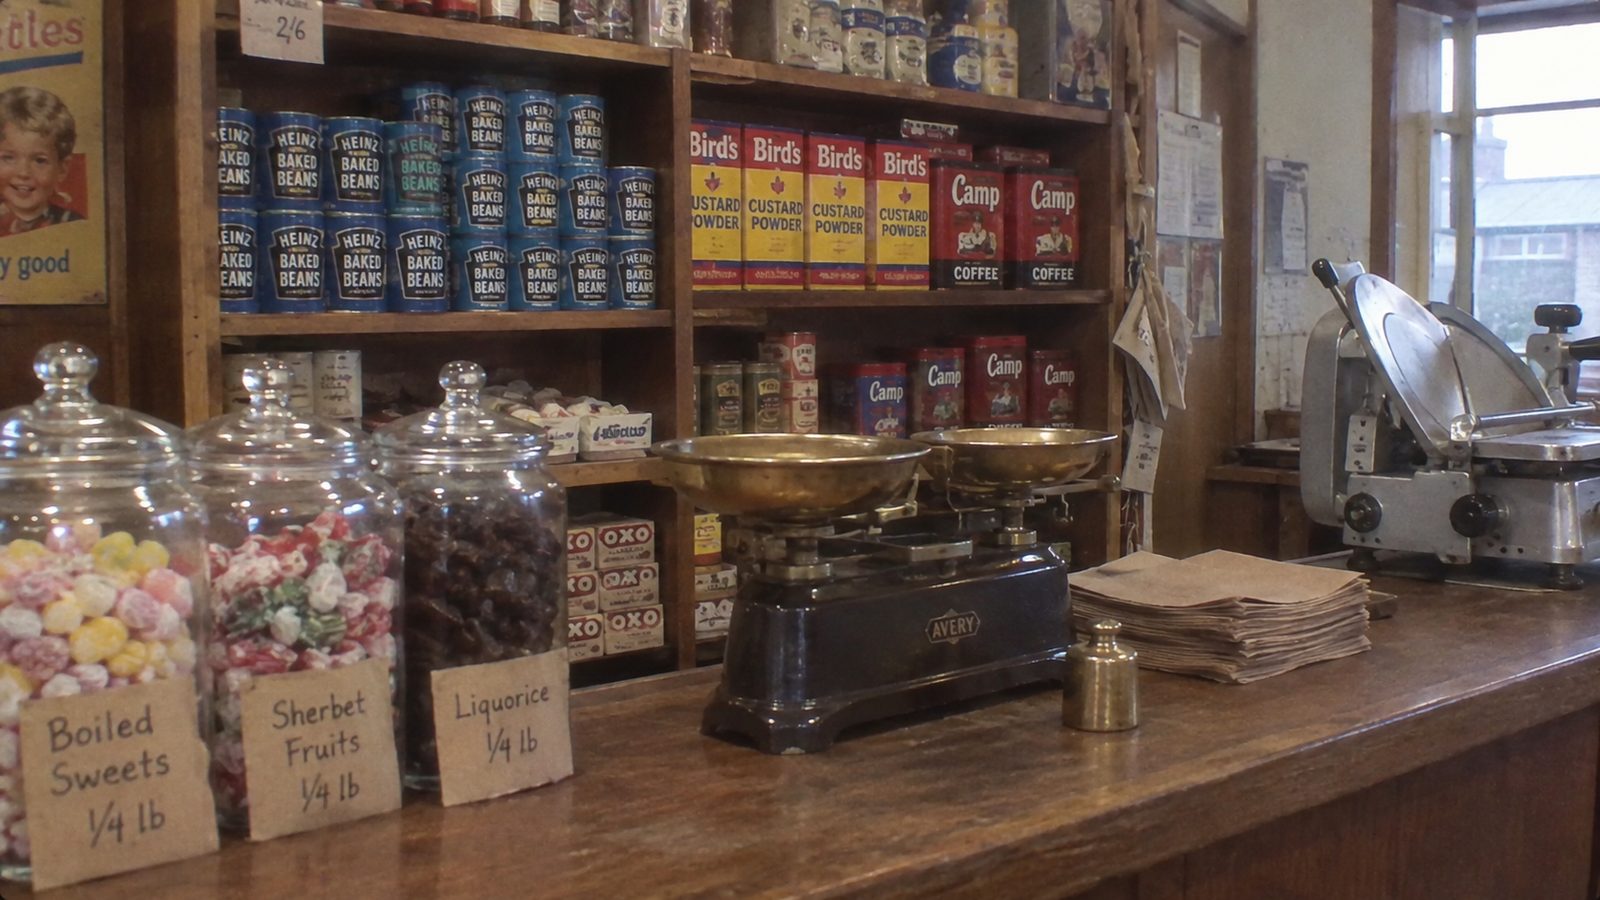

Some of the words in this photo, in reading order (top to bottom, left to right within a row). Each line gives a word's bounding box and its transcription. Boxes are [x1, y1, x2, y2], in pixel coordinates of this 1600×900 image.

[0, 9, 84, 51] tles
[472, 100, 502, 114] HEINZ
[525, 105, 552, 118] HEINZ
[574, 109, 600, 122] HEINZ
[472, 118, 502, 130] BAKED
[526, 121, 554, 132] BAKED
[574, 125, 602, 137] BAKED
[217, 128, 250, 145] EINZ
[277, 134, 316, 148] HEINZ
[472, 130, 502, 142] BEANS
[525, 134, 554, 146] BEANS
[341, 136, 378, 152] HEINZ
[574, 138, 602, 150] BEANS
[690, 131, 738, 160] Bird's
[754, 137, 801, 165] Bird's
[218, 151, 250, 166] AKED
[277, 154, 317, 169] BAKED
[342, 157, 379, 172] BAKED
[818, 144, 862, 170] Bird's
[884, 152, 926, 176] Bird's
[218, 168, 250, 184] EANS
[277, 172, 318, 188] BEANS
[341, 174, 380, 190] BEANS
[472, 174, 502, 186] HEINZ
[526, 177, 556, 190] HEINZ
[576, 180, 606, 192] HEINZ
[624, 182, 652, 194] HEINZ
[952, 174, 1000, 212] Camp
[472, 191, 503, 204] BAKED
[527, 193, 556, 206] BAKED
[578, 195, 606, 207] BAKED
[626, 198, 652, 208] BAKED
[692, 196, 740, 212] USTARD
[1031, 180, 1075, 214] Camp
[472, 204, 504, 218] BEANS
[527, 206, 557, 218] BEANS
[577, 208, 606, 220] BEANS
[750, 199, 803, 216] CUSTARD
[813, 204, 864, 218] CUSTARD
[880, 208, 928, 222] CUSTARD
[625, 210, 652, 222] BEANS
[691, 214, 740, 230] OWDER
[752, 216, 802, 231] POWDER
[816, 220, 864, 234] POWDER
[882, 224, 926, 238] POWDER
[218, 230, 252, 247] EINZ
[280, 232, 318, 248] HEINZ
[343, 233, 380, 249] HEINZ
[407, 235, 442, 250] HEINZ
[18, 248, 70, 280] good
[220, 253, 252, 268] AKED
[280, 253, 319, 269] BAKED
[344, 254, 382, 270] BAKED
[408, 256, 444, 270] BAKED
[474, 250, 504, 264] HEINZ
[527, 252, 556, 264] HEINZ
[578, 252, 606, 264] HEINZ
[626, 254, 653, 264] HEINZ
[220, 271, 253, 287] EANS
[280, 272, 320, 287] BEANS
[344, 272, 382, 287] BEANS
[408, 272, 444, 288] BEANS
[474, 268, 505, 280] BAKED
[528, 268, 557, 280] BAKED
[578, 268, 606, 280] BAKED
[626, 269, 653, 280] BAKED
[954, 266, 999, 280] COFFEE
[1032, 268, 1074, 280] COFFEE
[474, 281, 506, 294] BEANS
[528, 282, 558, 294] BEANS
[578, 282, 607, 294] BEANS
[626, 282, 654, 293] BEANS
[987, 354, 1022, 379] Camp
[928, 365, 962, 388] Camp
[1045, 364, 1075, 386] Camp
[870, 381, 903, 404] Camp
[604, 527, 650, 545] OXO
[604, 570, 653, 586] OXO
[611, 610, 658, 630] OXO
[932, 616, 974, 638] AVERY
[568, 620, 599, 637] XO
[272, 692, 365, 730] Sherbet
[456, 683, 550, 726] Liquorice
[48, 706, 154, 753] Boiled
[520, 729, 538, 754] lb
[286, 734, 360, 767] Fruits
[50, 750, 170, 796] Sweets
[340, 769, 360, 798] lb
[139, 804, 166, 836] lb
